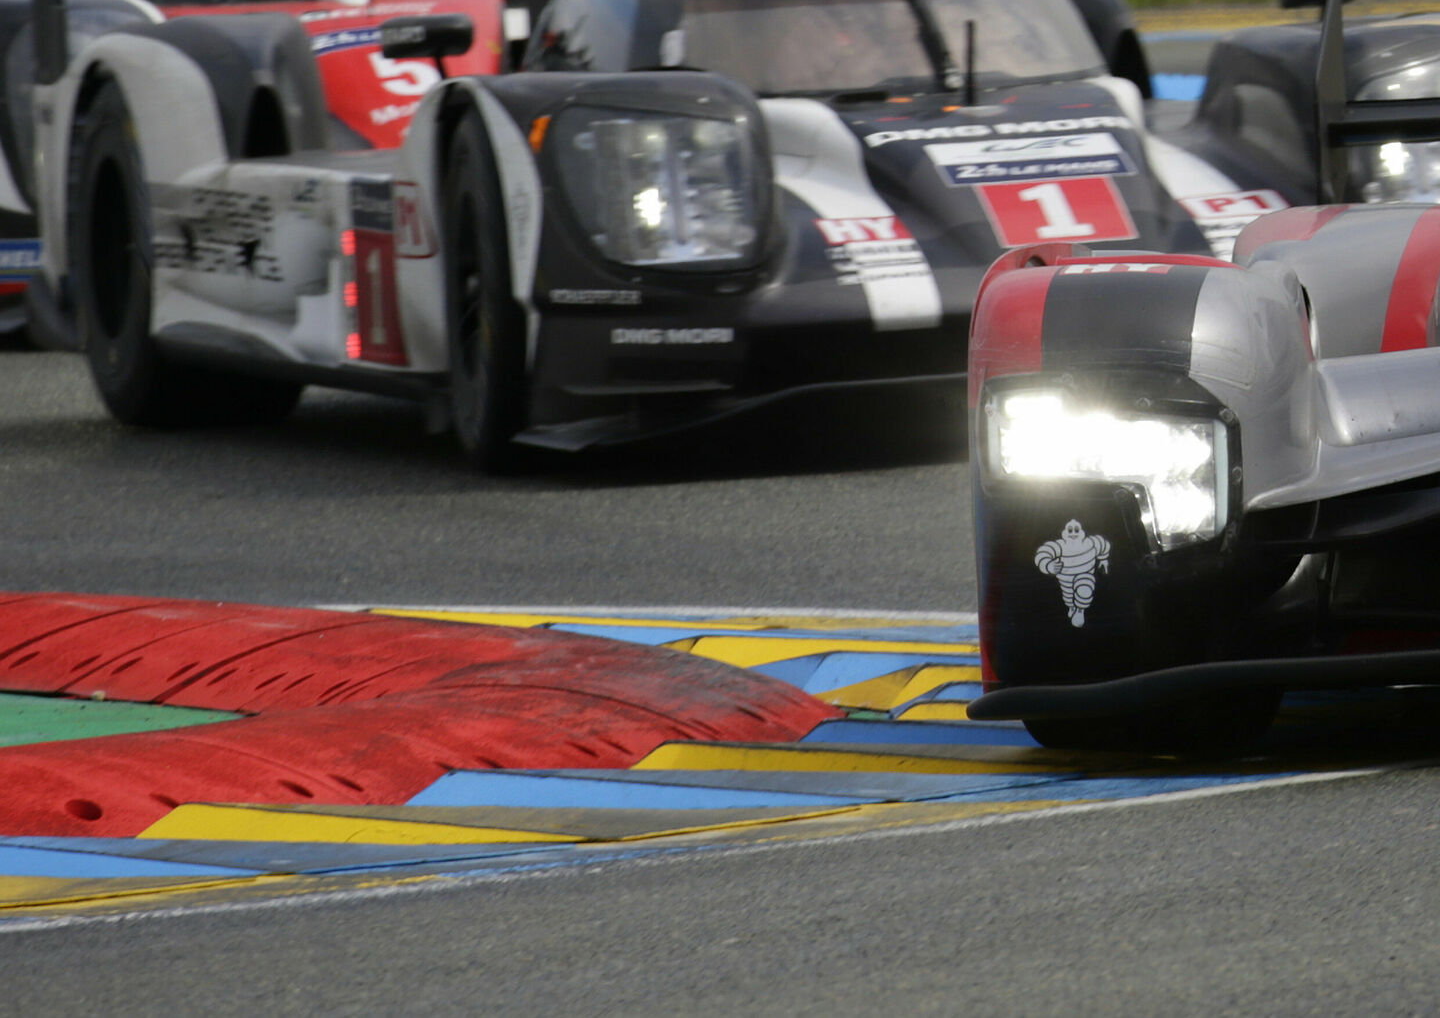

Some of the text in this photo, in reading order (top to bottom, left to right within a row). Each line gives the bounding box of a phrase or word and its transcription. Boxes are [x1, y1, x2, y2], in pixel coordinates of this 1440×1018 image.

[368, 52, 443, 96] 5
[1018, 182, 1096, 239] 1
[1202, 193, 1271, 213] P1
[816, 215, 899, 245] HY
[365, 248, 387, 346] 1
